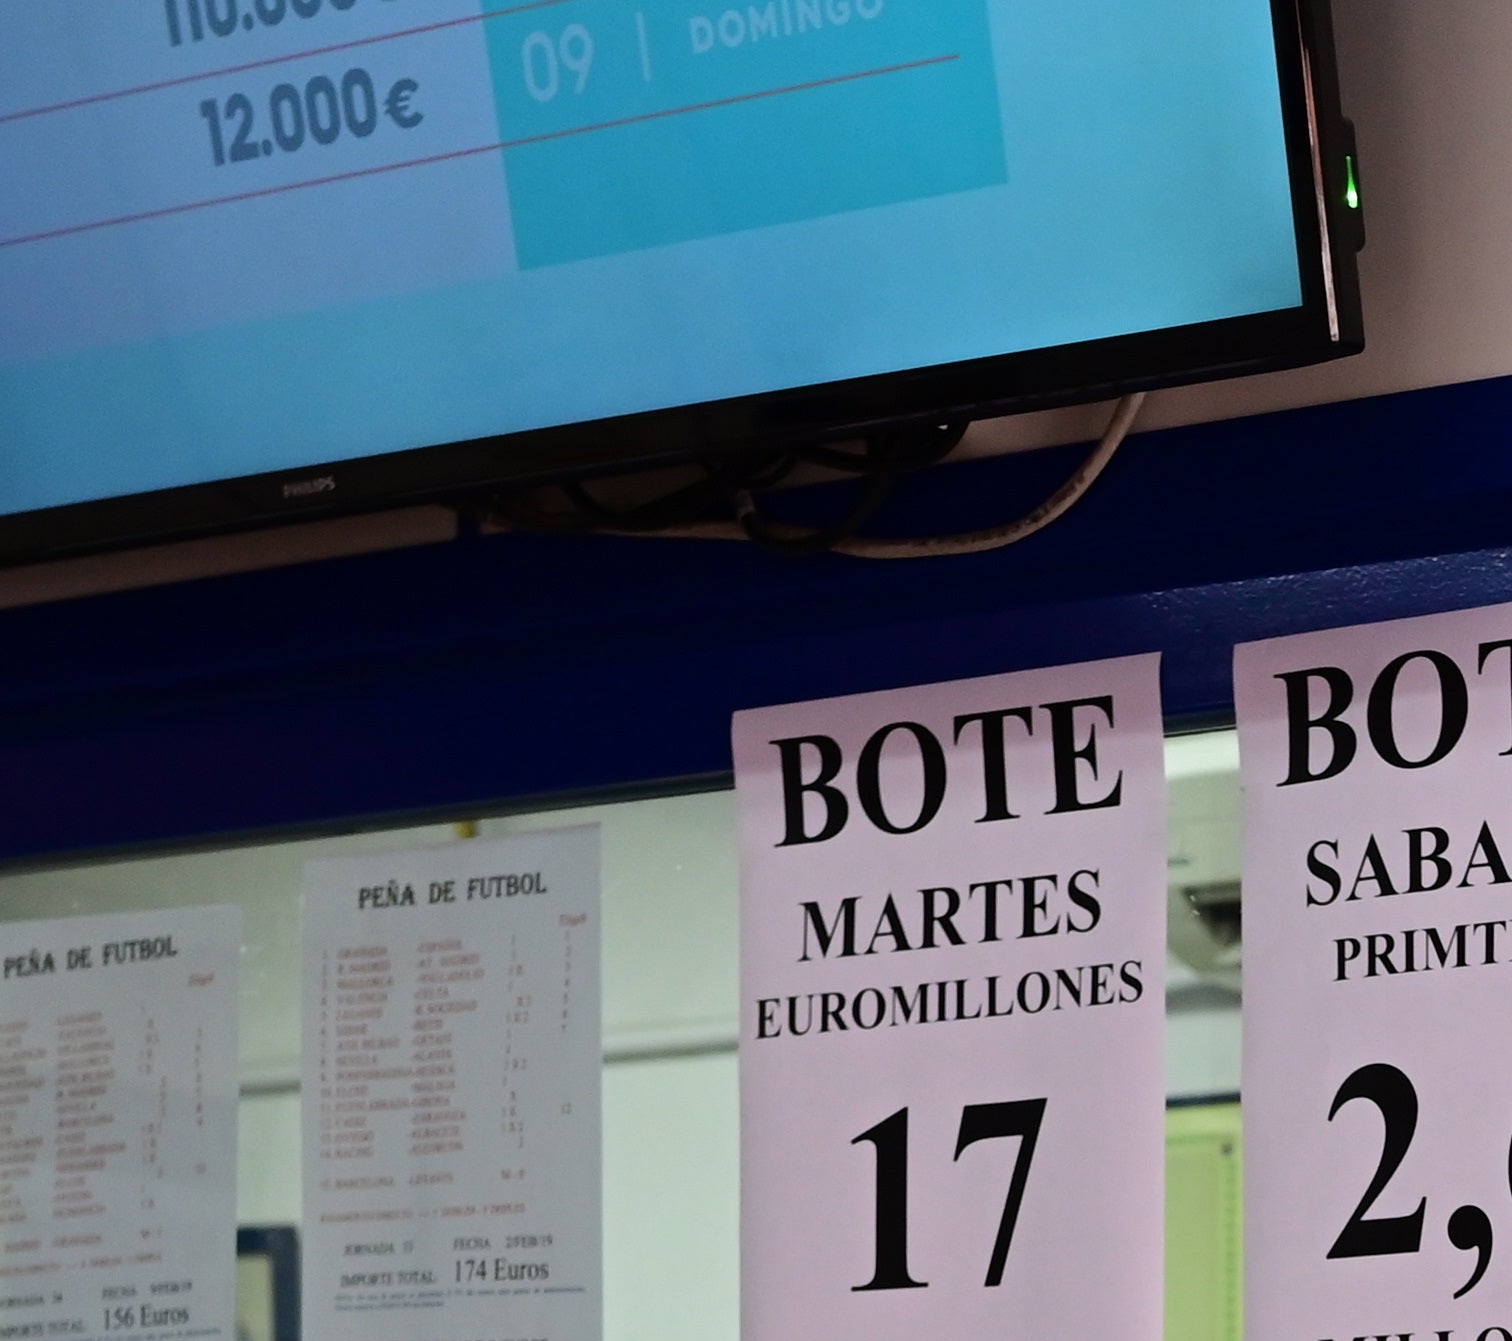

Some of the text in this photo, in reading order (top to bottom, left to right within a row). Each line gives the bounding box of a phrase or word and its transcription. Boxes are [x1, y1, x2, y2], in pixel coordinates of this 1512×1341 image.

[522, 22, 596, 102] 09
[770, 694, 1124, 849] BOTE
[358, 870, 549, 910] PEÑA DE FUTBOL
[797, 869, 1102, 963] MARTES
[754, 960, 1143, 1040] EUROMILLONES
[849, 1096, 1047, 1293] 17
[453, 1257, 551, 1284] 174 Euros
[140, 1304, 190, 1328] Euros
